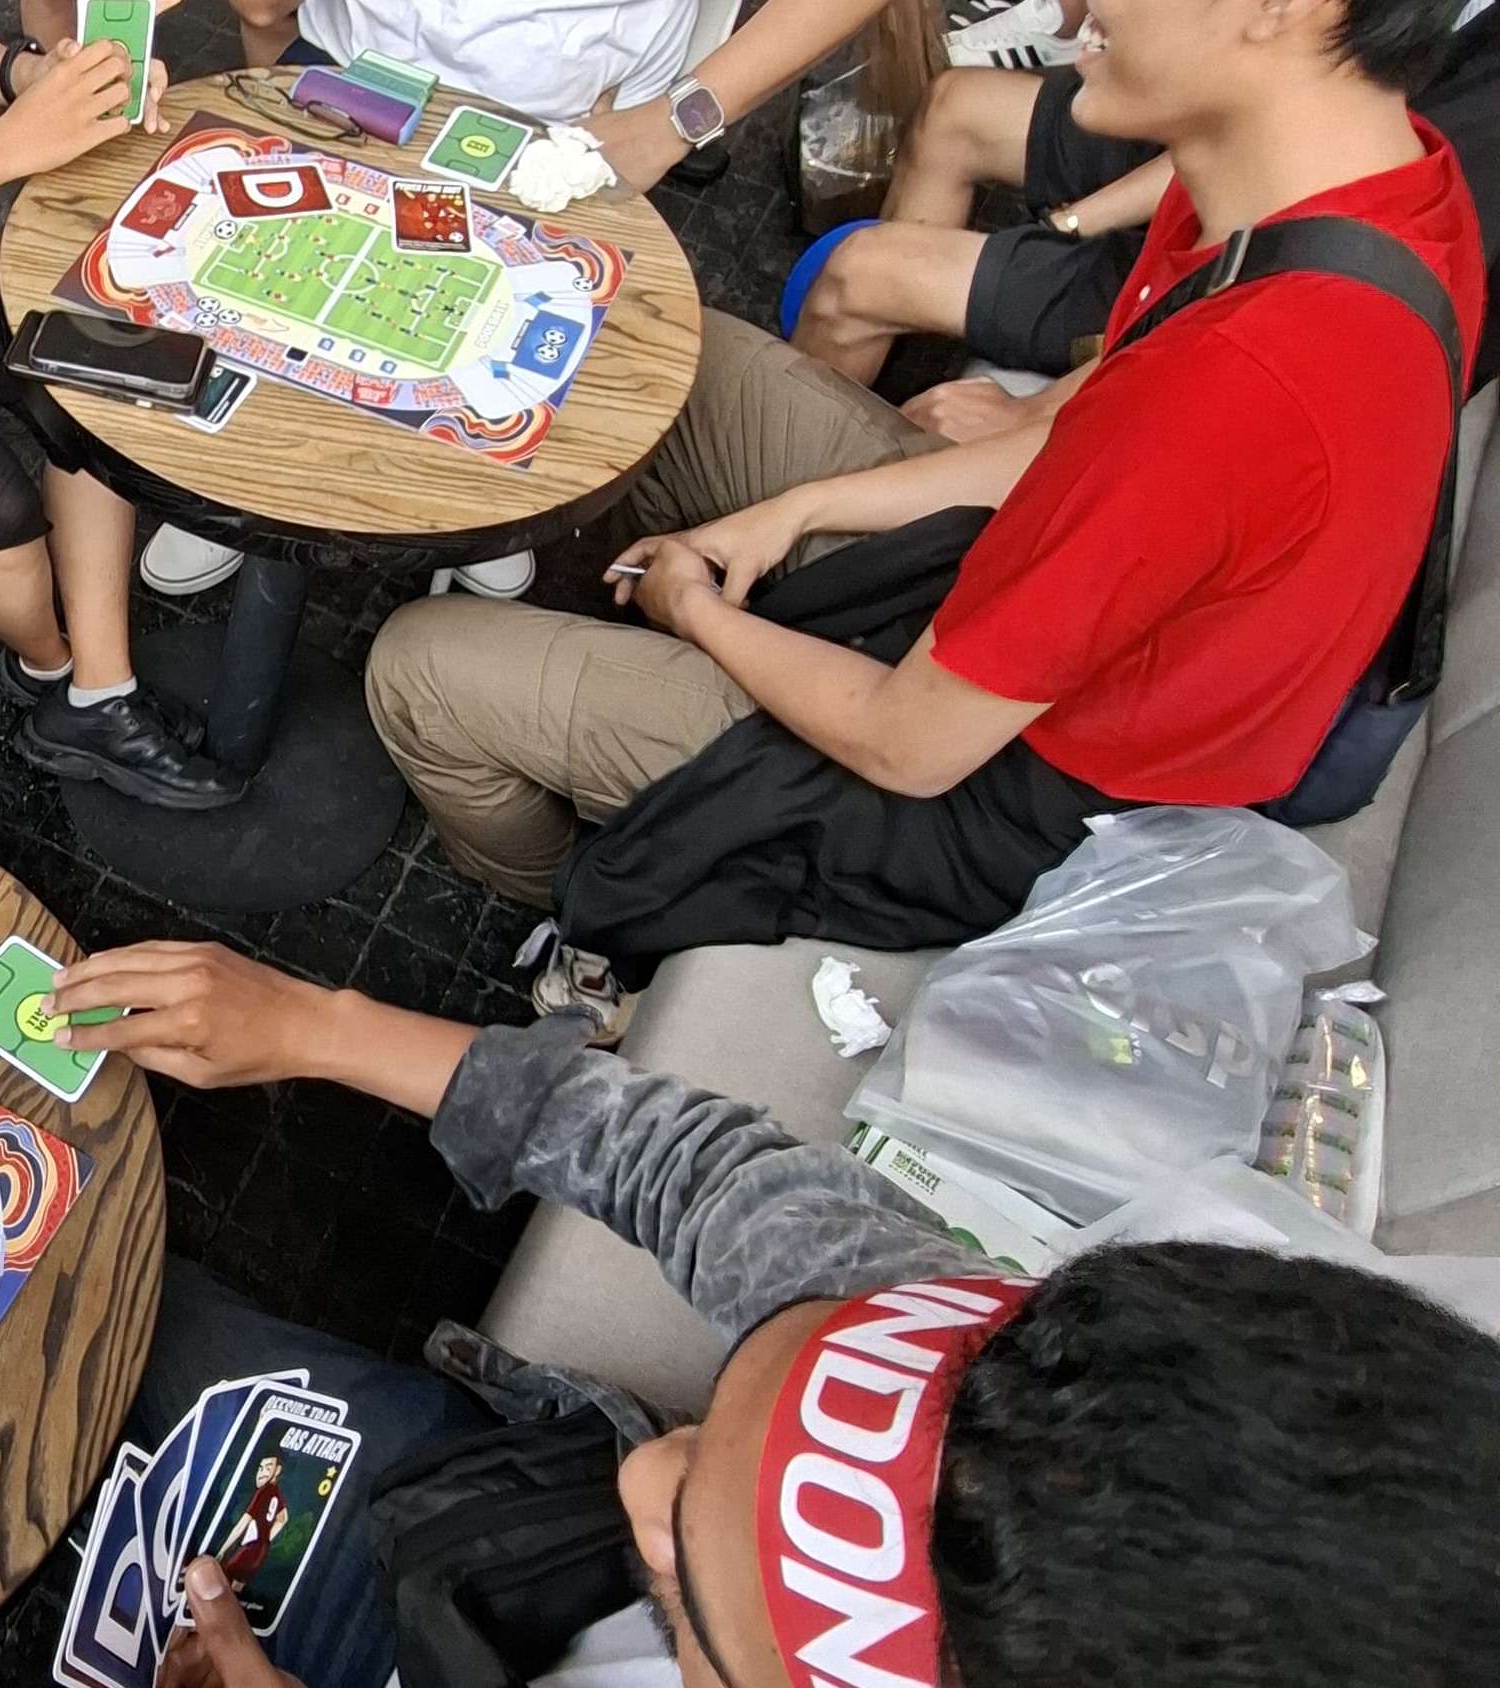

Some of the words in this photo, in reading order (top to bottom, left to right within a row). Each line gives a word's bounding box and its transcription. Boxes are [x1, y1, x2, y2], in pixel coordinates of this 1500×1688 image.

[242, 171, 304, 208] D
[279, 1426, 307, 1453] GAS
[301, 1434, 351, 1464] ATTACK
[780, 1283, 1004, 1688] INDON
[265, 1496, 279, 1522] 9
[94, 1535, 148, 1668] D
